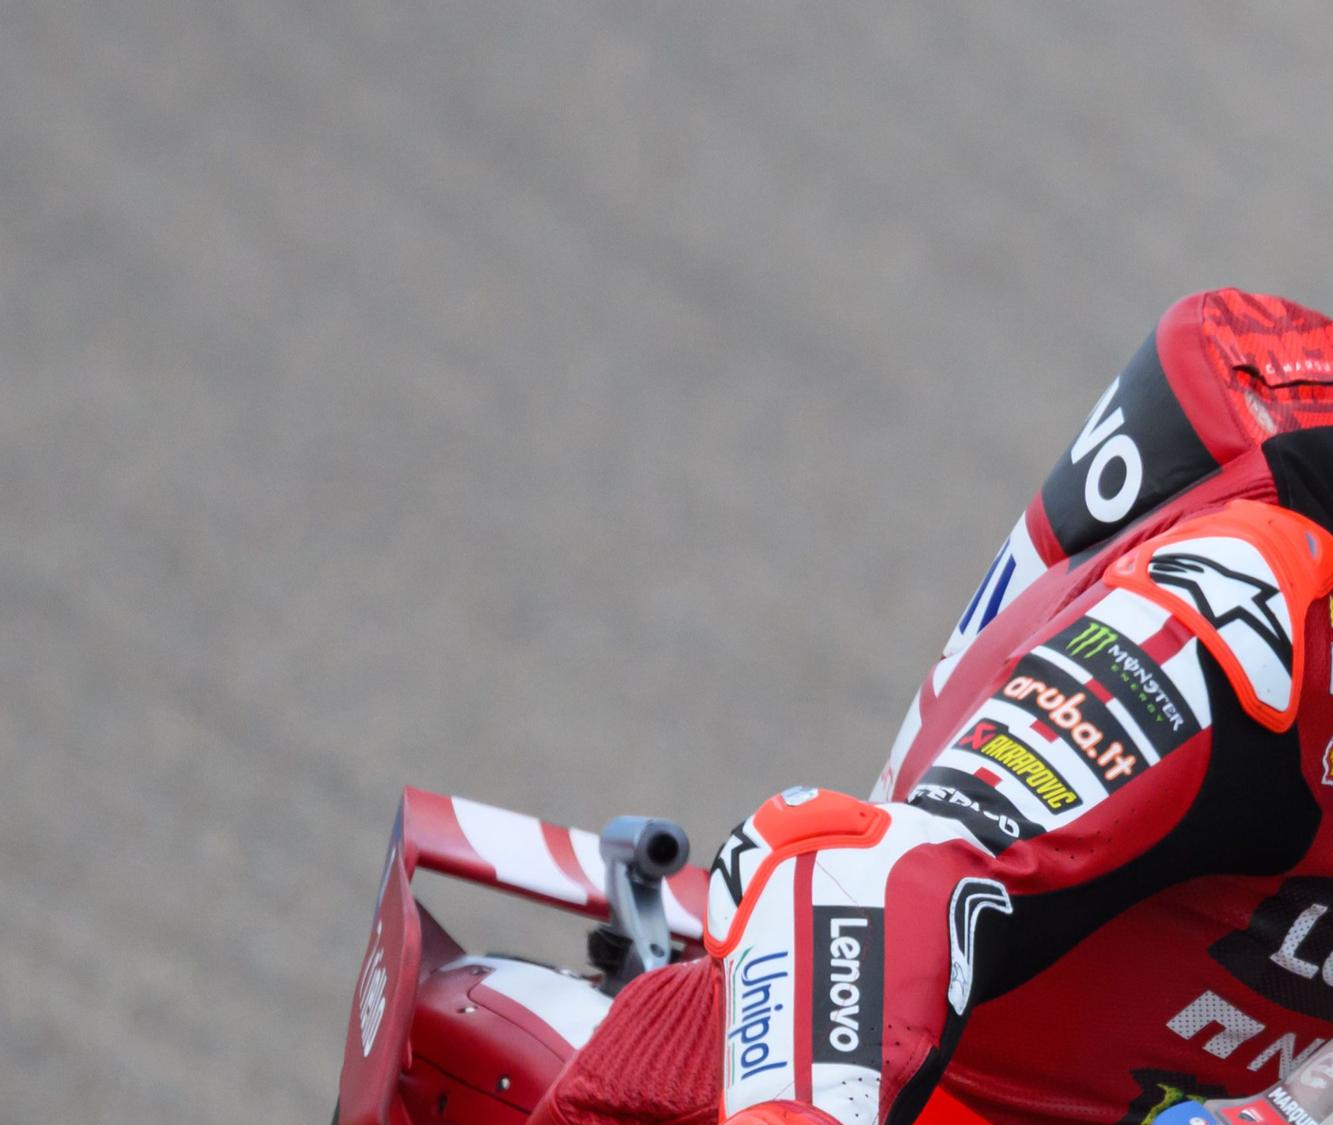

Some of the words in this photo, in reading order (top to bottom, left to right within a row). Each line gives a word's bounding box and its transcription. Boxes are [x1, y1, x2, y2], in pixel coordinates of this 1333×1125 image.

[1003, 675, 1136, 782] aruba.it
[1108, 644, 1185, 732] MONSTER
[728, 949, 789, 1081] Unipol
[828, 916, 869, 1053] Lenovo
